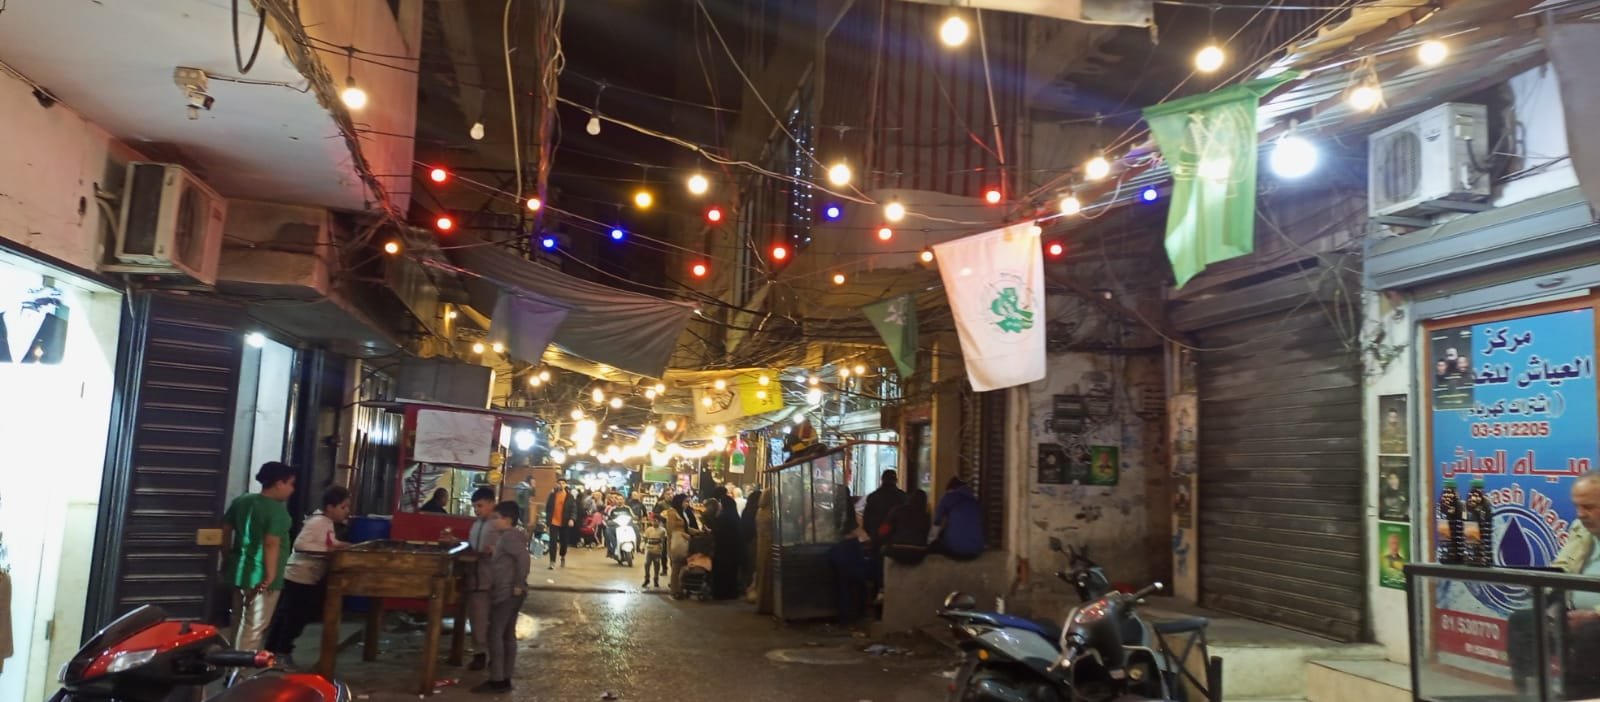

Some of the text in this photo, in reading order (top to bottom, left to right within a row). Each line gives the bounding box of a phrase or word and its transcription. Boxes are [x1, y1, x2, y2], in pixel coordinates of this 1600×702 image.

[1481, 327, 1532, 355] مركز
[1516, 355, 1591, 388] العياش
[1472, 422, 1551, 438] 03-512205
[1441, 446, 1506, 480] العياش
[1488, 482, 1525, 507] ash
